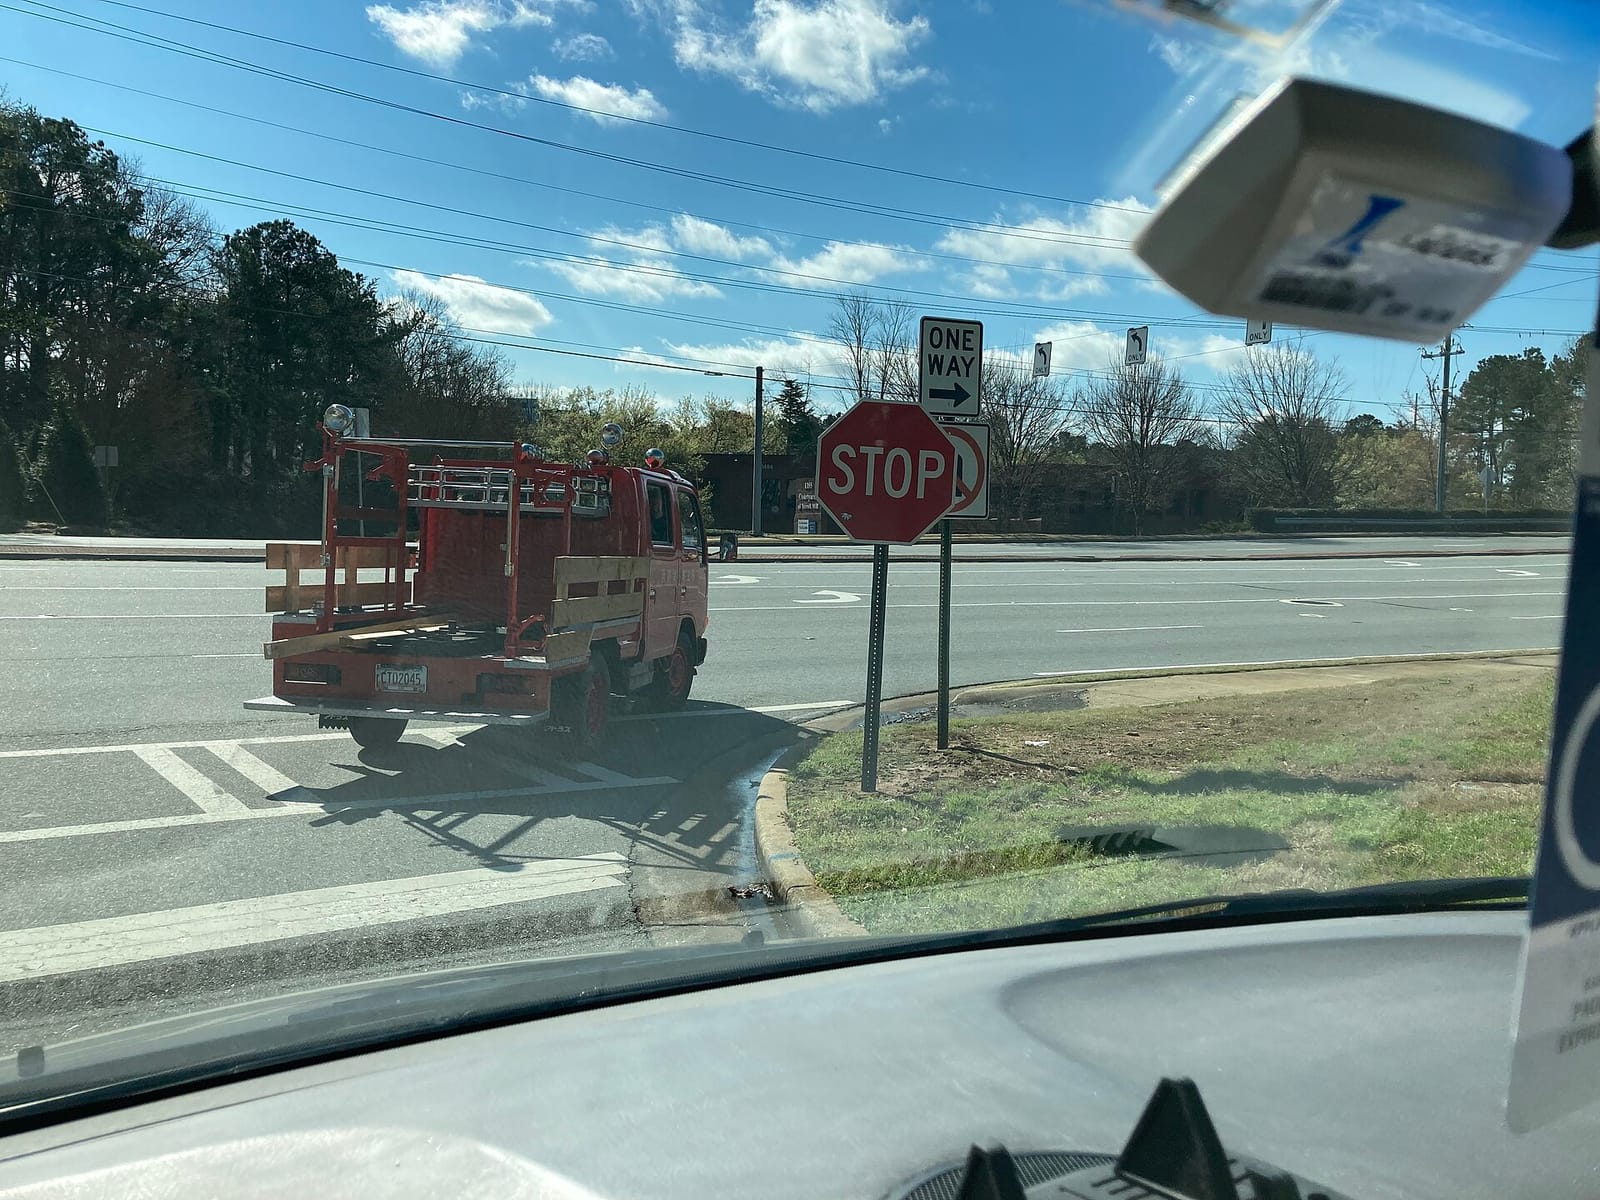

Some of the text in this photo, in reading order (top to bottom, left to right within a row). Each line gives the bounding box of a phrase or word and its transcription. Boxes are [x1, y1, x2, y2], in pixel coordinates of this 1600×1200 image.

[929, 326, 975, 351] ONE
[1249, 330, 1268, 342] ONLY
[928, 353, 975, 378] WAY
[1127, 353, 1143, 362] ONLY
[1034, 366, 1048, 374] ONLY
[828, 443, 946, 499] STOP
